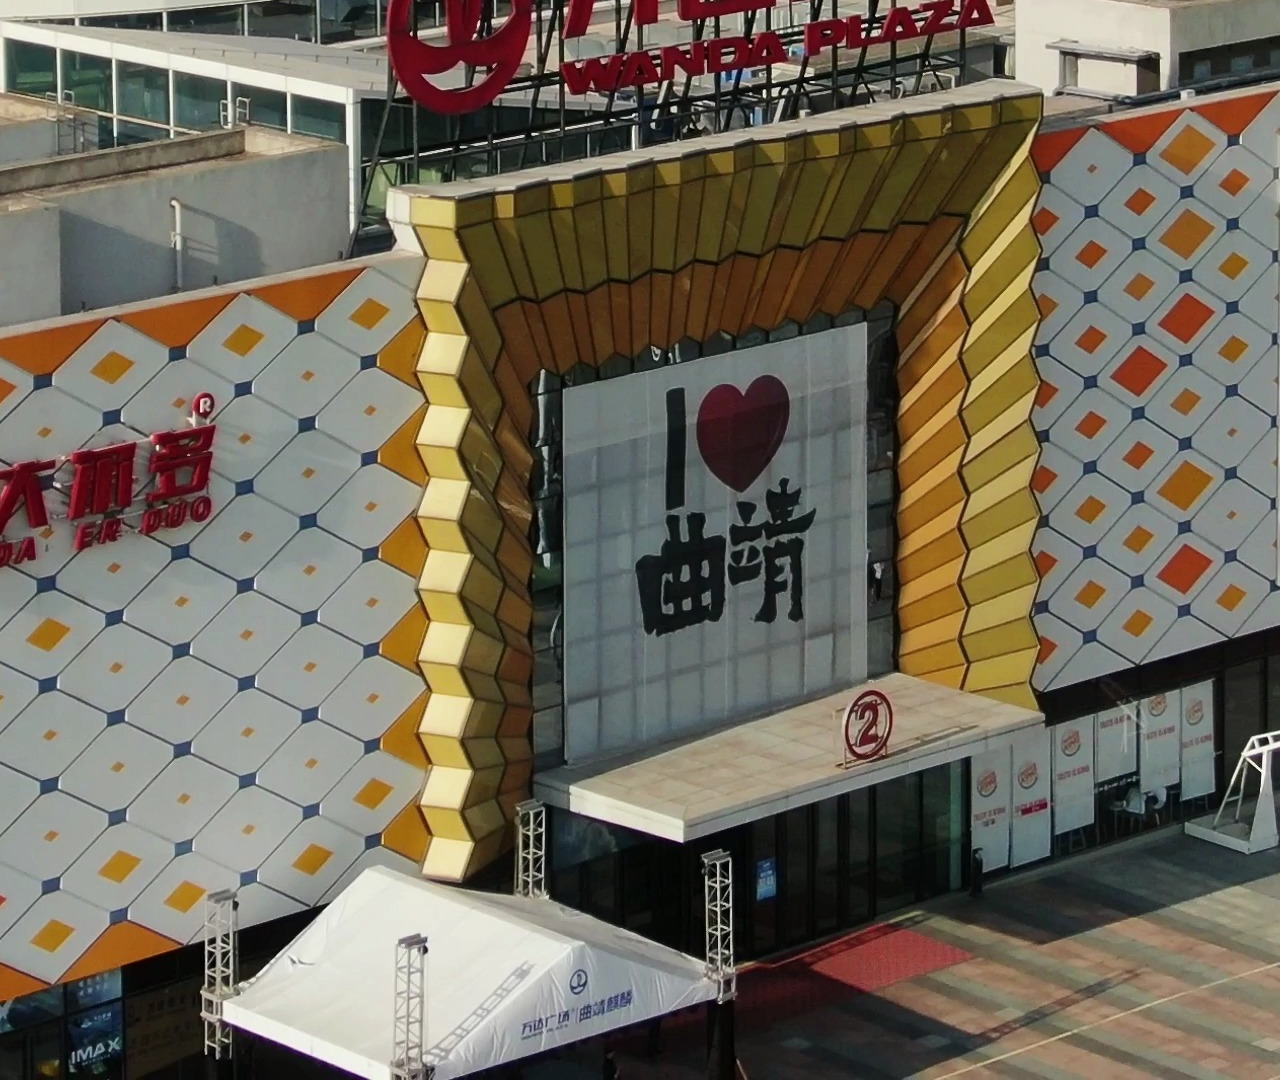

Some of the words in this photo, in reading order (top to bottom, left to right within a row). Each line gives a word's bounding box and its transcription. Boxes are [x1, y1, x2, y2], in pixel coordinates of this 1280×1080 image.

[560, 32, 788, 95] WANDA
[666, 387, 686, 510] I
[139, 496, 212, 536] DUO
[635, 477, 817, 637] 曲靖
[521, 1009, 570, 1036] 万达广场
[71, 1036, 121, 1063] IMAX
